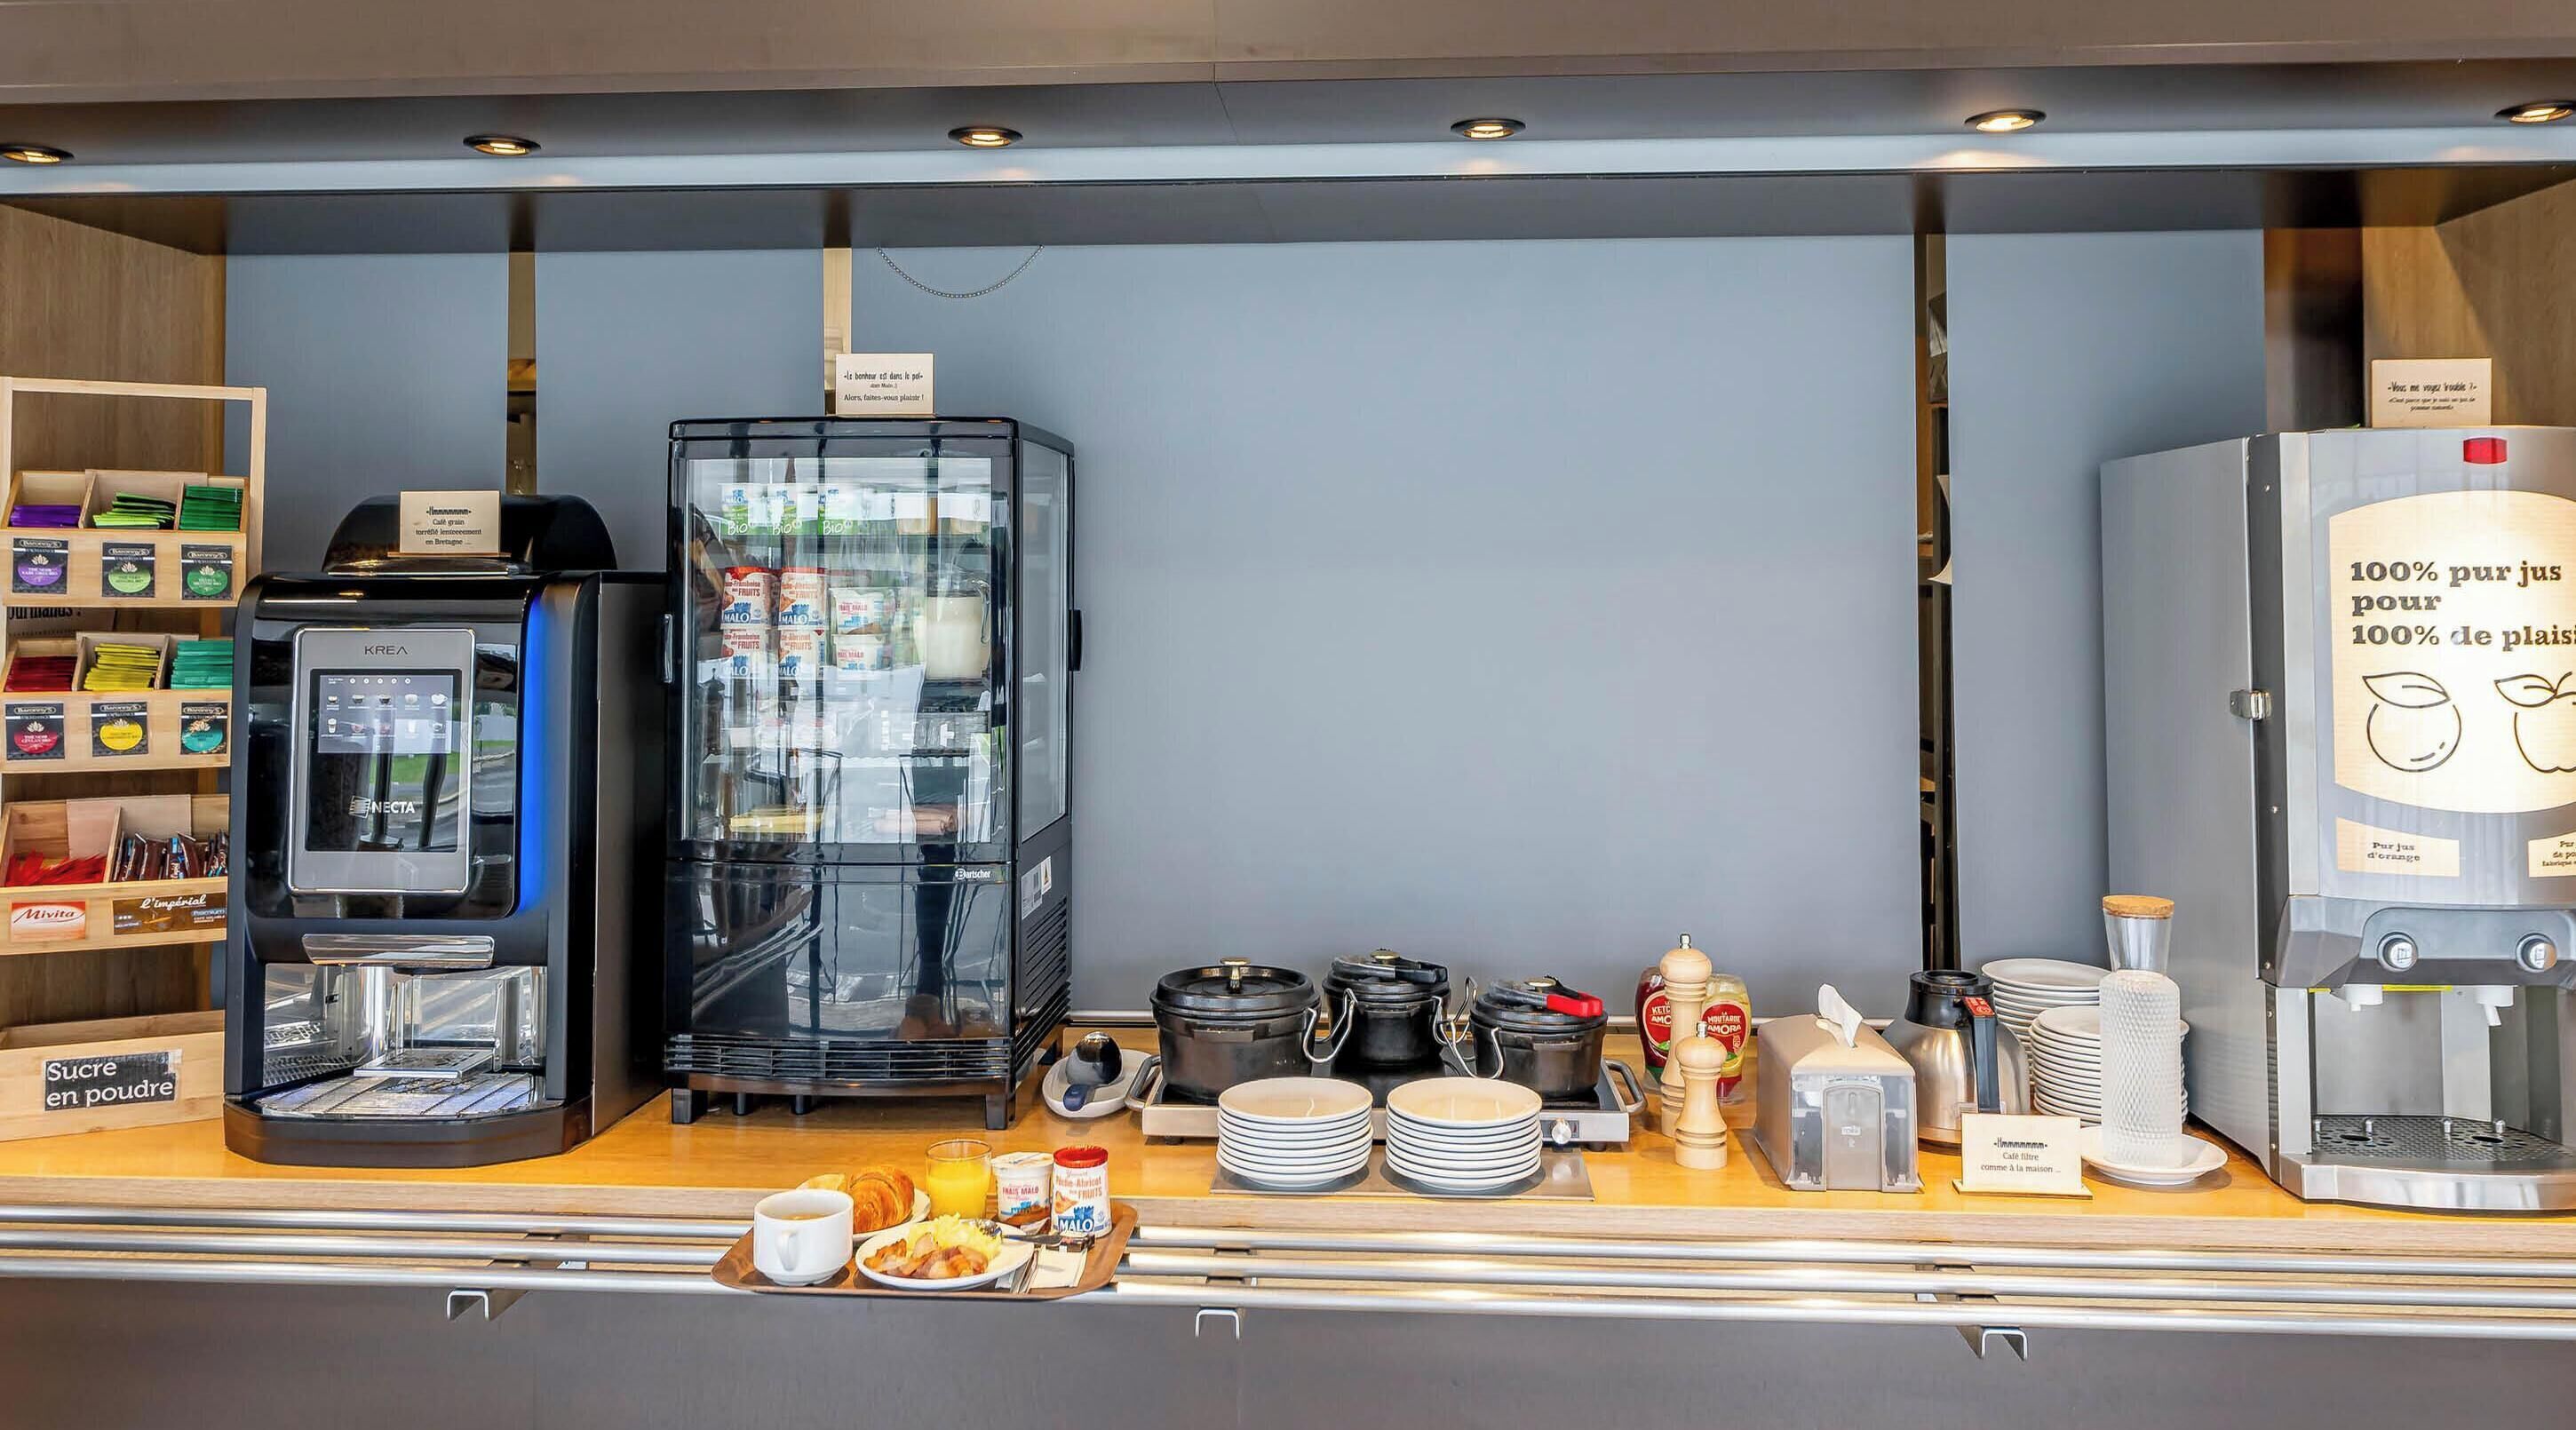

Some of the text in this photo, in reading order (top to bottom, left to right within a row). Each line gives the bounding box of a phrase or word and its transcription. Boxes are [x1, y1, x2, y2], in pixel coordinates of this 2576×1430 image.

[855, 371, 877, 380] bonheur
[889, 371, 902, 380] dans
[904, 370, 910, 380] le
[2423, 384, 2441, 393] voyez
[2444, 382, 2466, 392] trouble
[844, 393, 863, 402] Alors,
[900, 393, 920, 402] plaisir
[727, 520, 748, 536] Bio
[772, 521, 792, 536] Bio
[823, 520, 843, 536] Bio
[434, 537, 463, 546] Bretagne
[2350, 560, 2562, 588] 100% pur jus
[738, 588, 760, 597] FRUITS
[2351, 595, 2442, 616] pour
[723, 613, 751, 624] MALO
[782, 614, 808, 624] MALO
[2352, 624, 2576, 652] 100% de plaisi
[364, 646, 409, 655] KREA
[371, 801, 416, 814] NECTA
[2373, 841, 2415, 852] Pur jus
[2366, 852, 2421, 863] d'orange
[955, 868, 992, 880] Bartscher
[20, 908, 76, 919] Mivita
[1650, 1015, 1671, 1025] AMO
[1707, 1014, 1741, 1023] MOUTARDE
[1707, 1024, 1742, 1036] AMORA
[46, 1061, 117, 1083] Sucre
[46, 1079, 174, 1108] en poudre
[2002, 1152, 2039, 1162] Café filtre
[1002, 1186, 1039, 1196] FRAIS MALO
[1078, 1187, 1102, 1199] FRUITS
[1060, 1217, 1094, 1232] MALO
